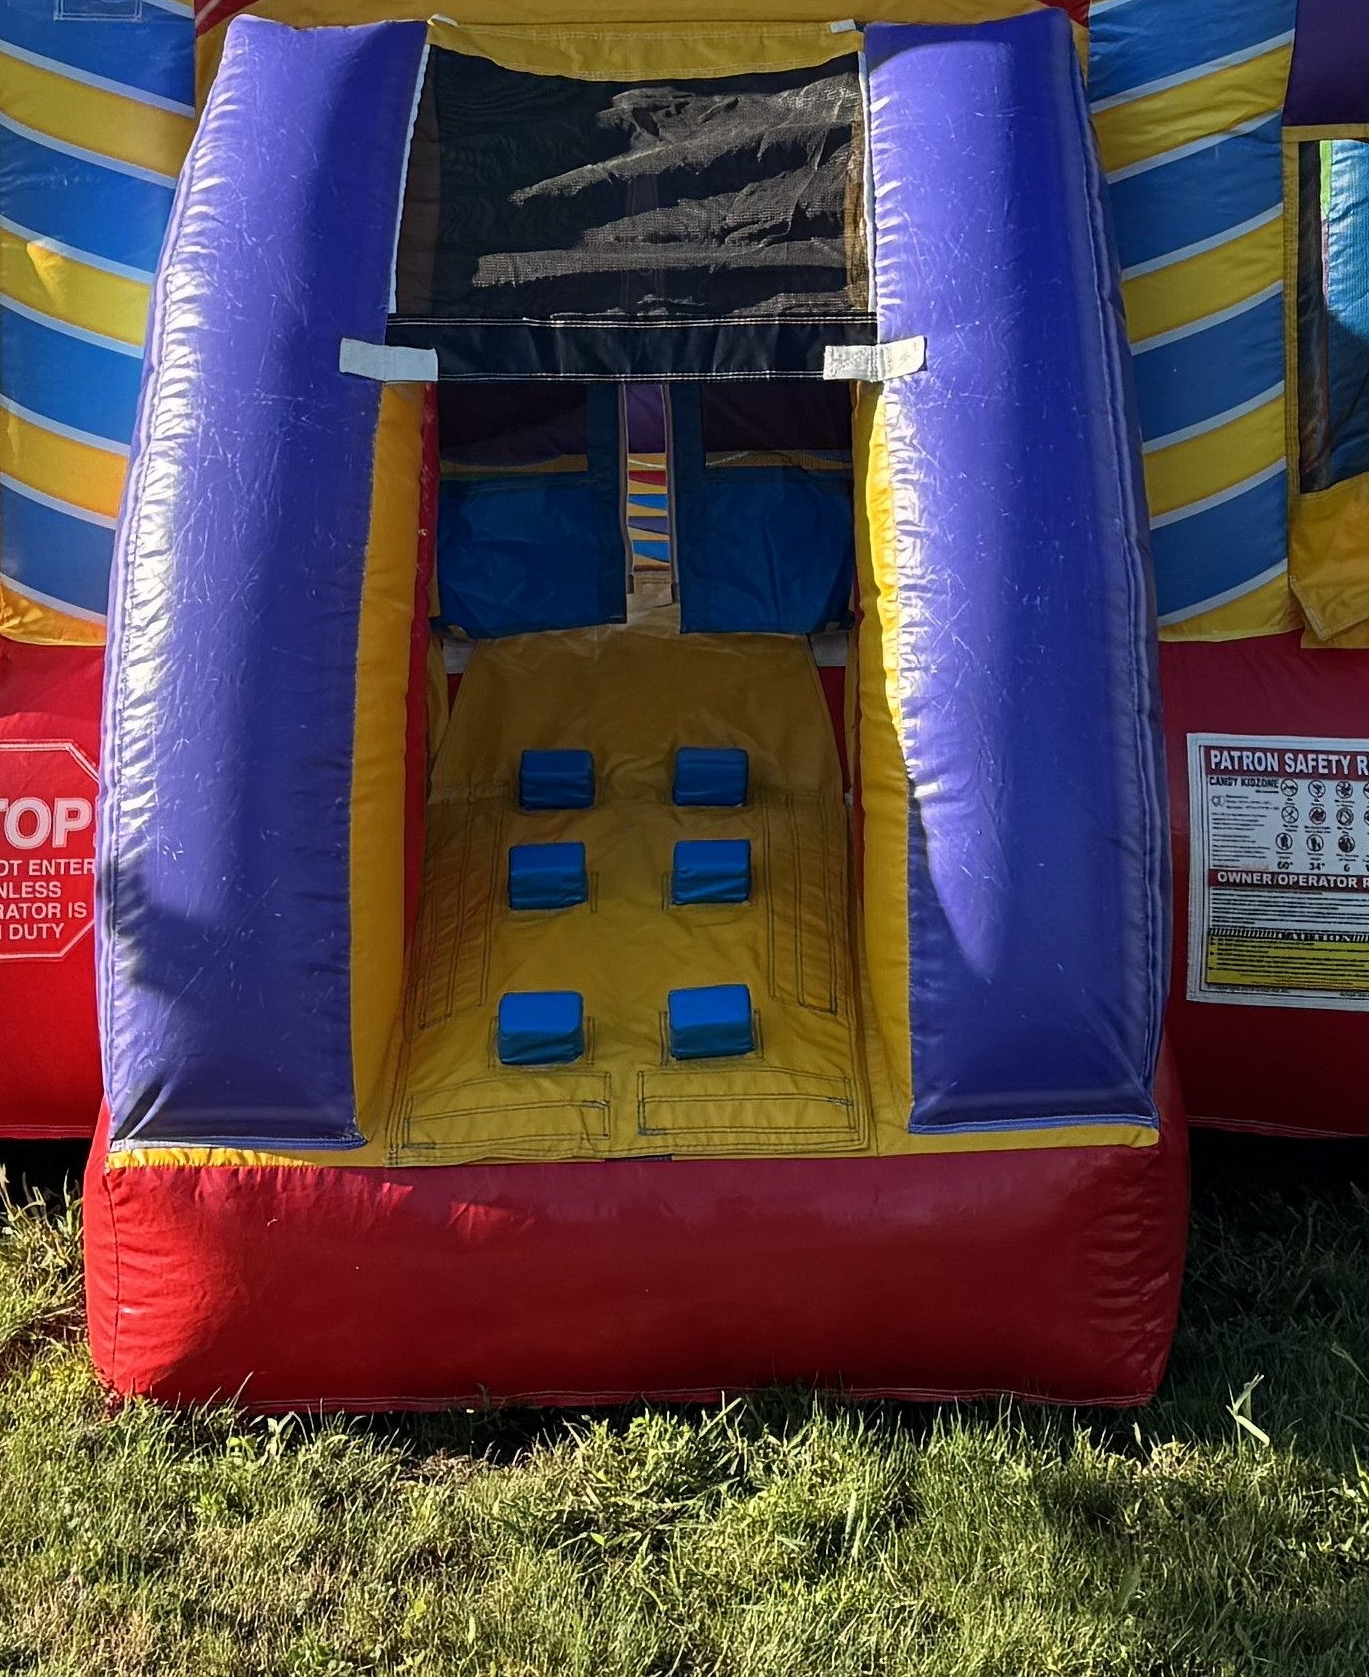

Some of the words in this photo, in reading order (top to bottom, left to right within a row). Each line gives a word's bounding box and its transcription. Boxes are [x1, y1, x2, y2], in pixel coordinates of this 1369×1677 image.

[1210, 749, 1279, 772] PATRON
[1284, 753, 1350, 775] SAFETY
[1217, 871, 1358, 889] OWNER/OPERATOR
[67, 902, 87, 919] IS
[9, 923, 65, 940] DUTY
